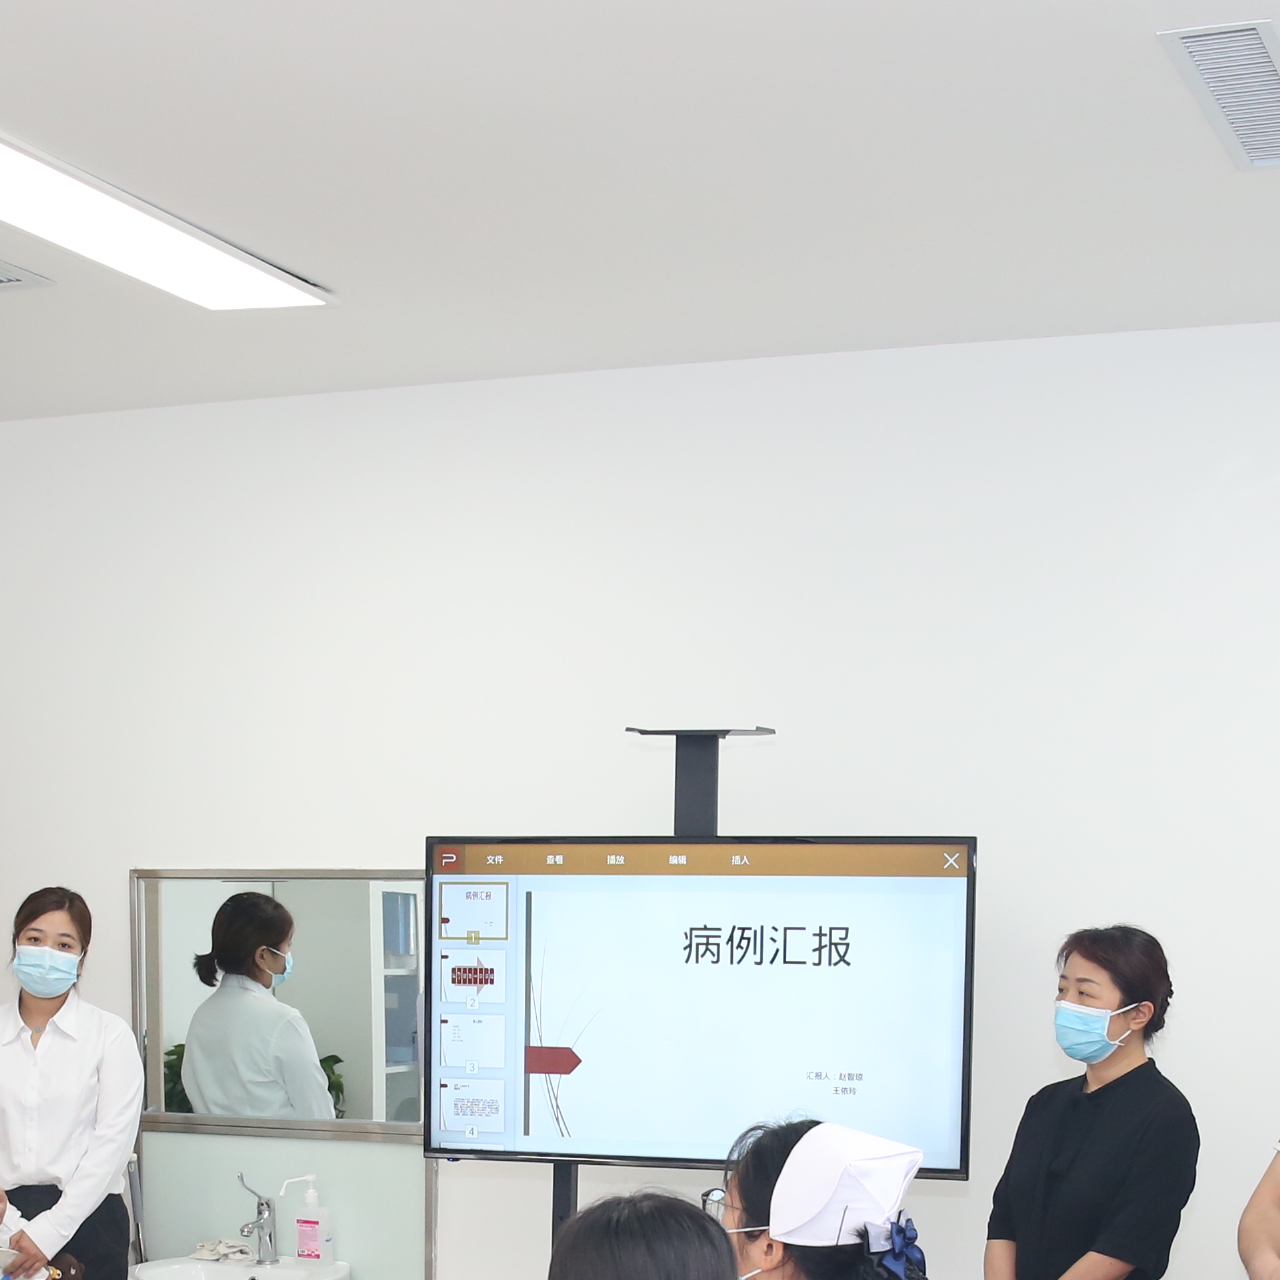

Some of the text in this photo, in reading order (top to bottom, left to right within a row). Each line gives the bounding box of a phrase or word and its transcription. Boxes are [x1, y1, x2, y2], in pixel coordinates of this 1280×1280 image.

[486, 855, 504, 865] 文件
[546, 855, 564, 865] 查看
[606, 855, 625, 865] 播放
[668, 855, 687, 865] 编辑
[731, 855, 750, 866] 插入
[465, 891, 492, 900] 病例汇报
[683, 924, 851, 967] 病例汇报
[469, 998, 476, 1007] 2
[469, 1063, 475, 1072] 3
[468, 1127, 474, 1136] 4
